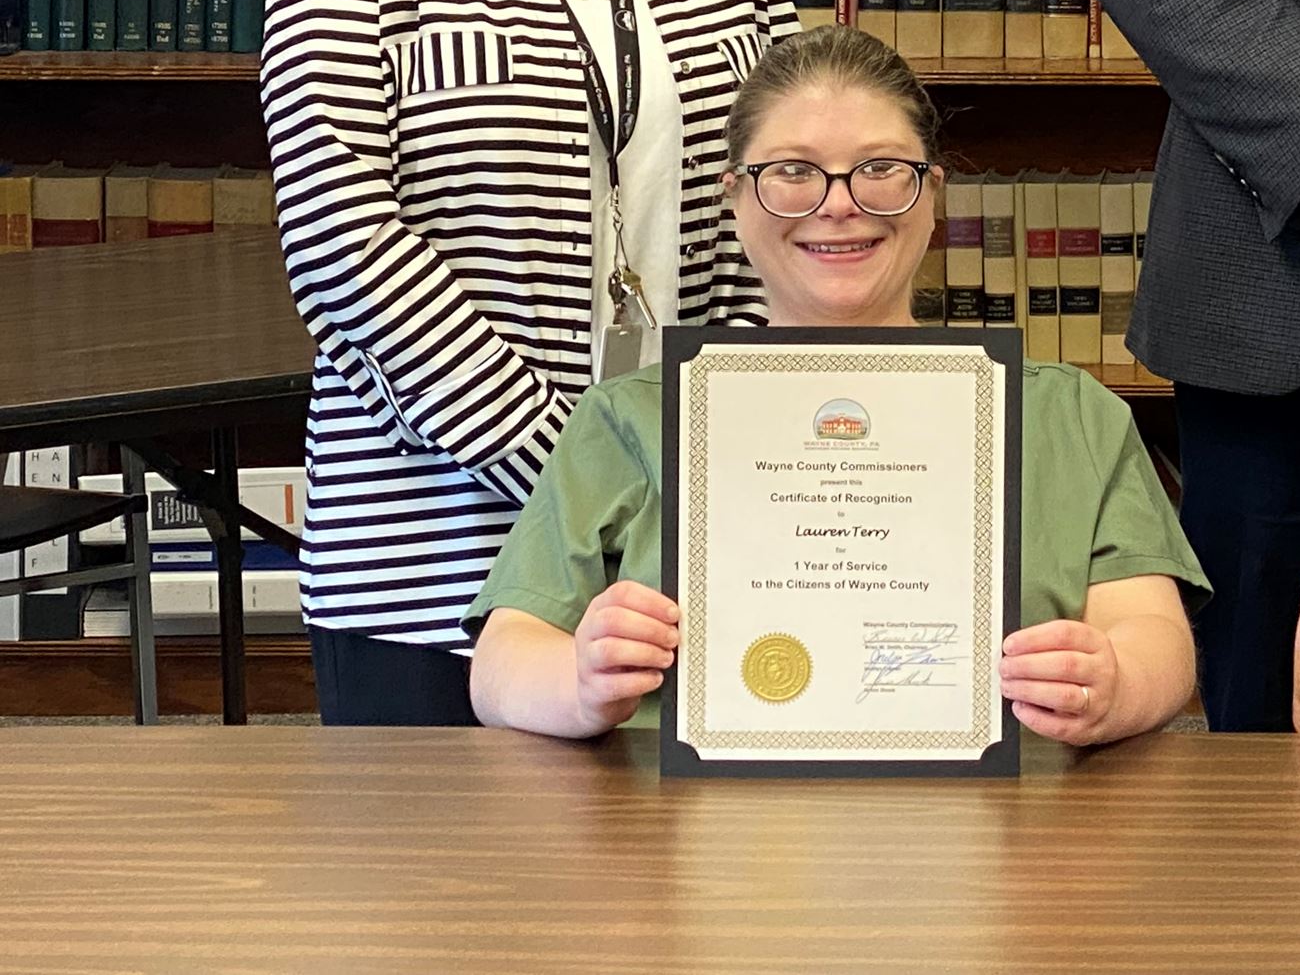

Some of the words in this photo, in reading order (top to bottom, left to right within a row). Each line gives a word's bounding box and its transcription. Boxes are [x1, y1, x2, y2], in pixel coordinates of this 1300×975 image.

[755, 460, 793, 473] Wayne
[796, 460, 837, 473] County
[840, 461, 928, 473] Commissioners
[820, 479, 848, 487] present
[770, 492, 828, 503] Certificate
[830, 492, 842, 503] of
[845, 493, 912, 505] Recognition
[795, 525, 850, 538] Lauren
[852, 526, 890, 541] Terry
[835, 546, 846, 554] for
[793, 562, 799, 571] 1
[803, 561, 829, 571] Year
[832, 561, 844, 571] of
[846, 561, 888, 571] Service
[751, 580, 763, 589] to
[765, 579, 783, 589] the
[786, 579, 831, 589] Citizens
[834, 580, 846, 589] of
[848, 580, 887, 592] Wayne
[889, 580, 930, 592] County
